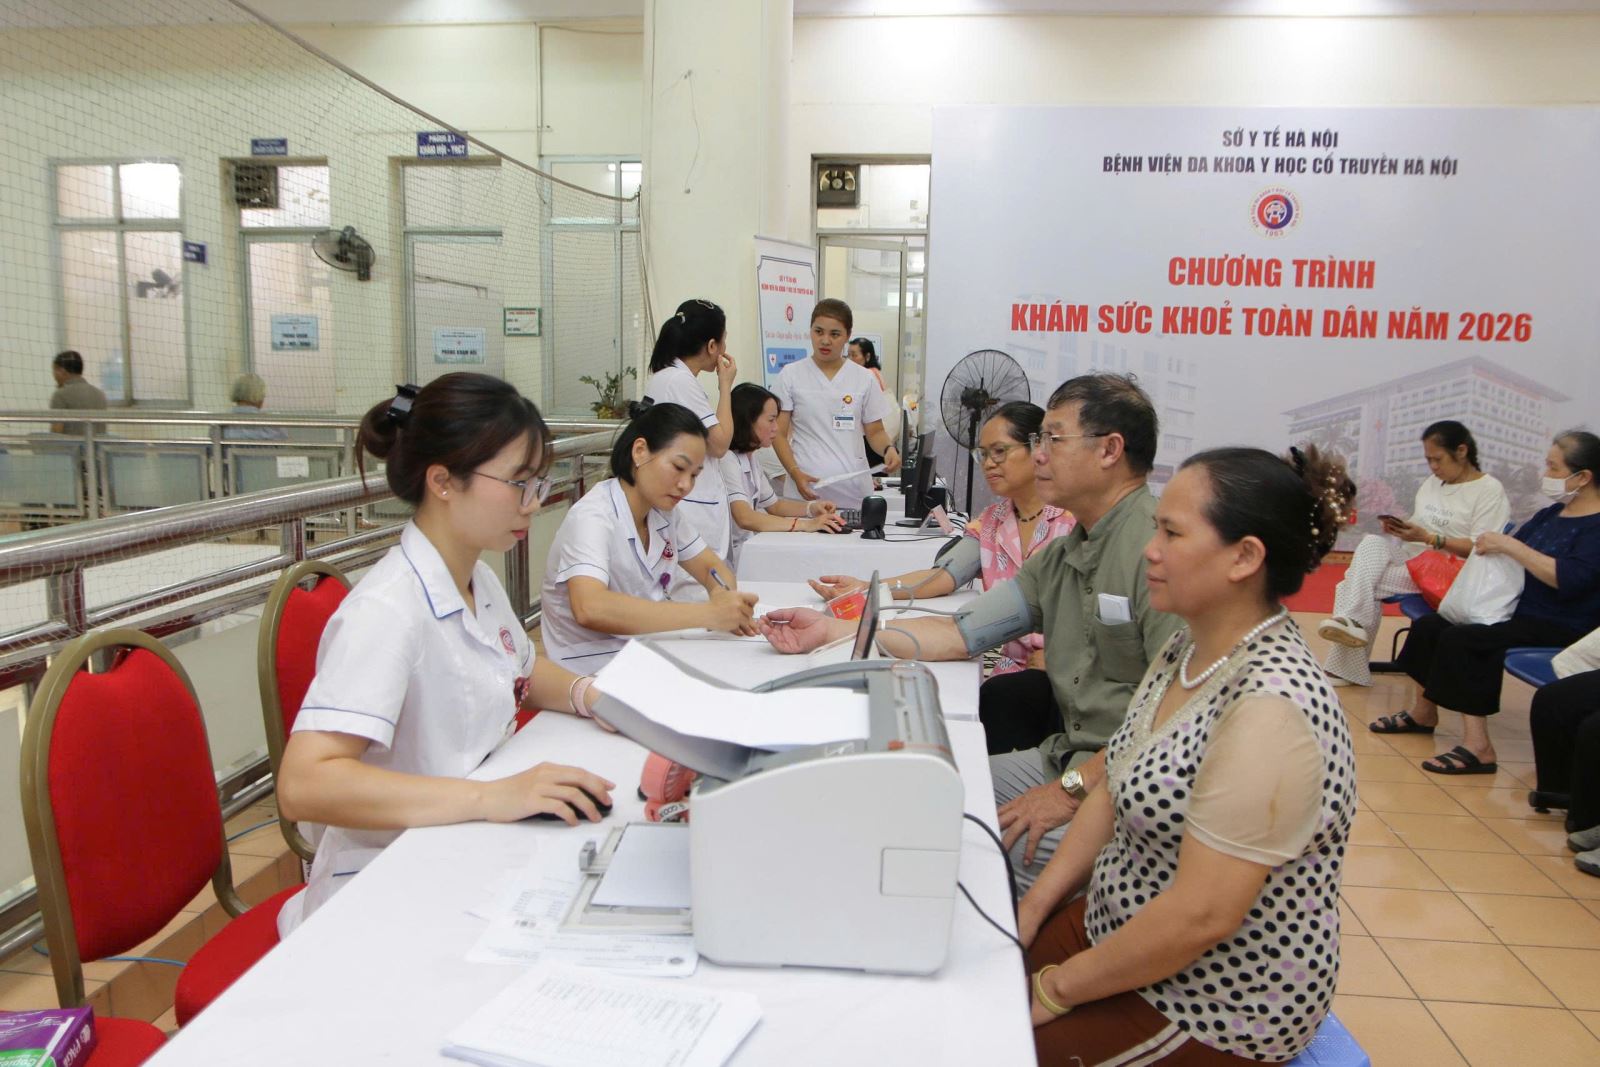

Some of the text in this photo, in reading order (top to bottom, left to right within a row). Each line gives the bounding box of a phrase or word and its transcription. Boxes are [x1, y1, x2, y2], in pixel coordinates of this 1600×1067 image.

[1222, 125, 1339, 151] SỞ Y TẾ HÀ NỘI
[1102, 153, 1143, 176] BỆNH
[1148, 153, 1182, 176] VIỆN
[1213, 156, 1256, 173] KHOA
[1260, 156, 1270, 173] Y
[1274, 156, 1307, 176] HỌC
[1312, 152, 1334, 174] CỔ
[1339, 152, 1399, 175] TRUYỀN
[1403, 155, 1425, 175] HÀ
[1429, 155, 1458, 178] NỘI
[1168, 253, 1376, 289] CHƯƠNG TRÌNH
[1011, 300, 1533, 342] KHÁM SỨC KHOẺ TOÀN DÂN NĂM 2026
